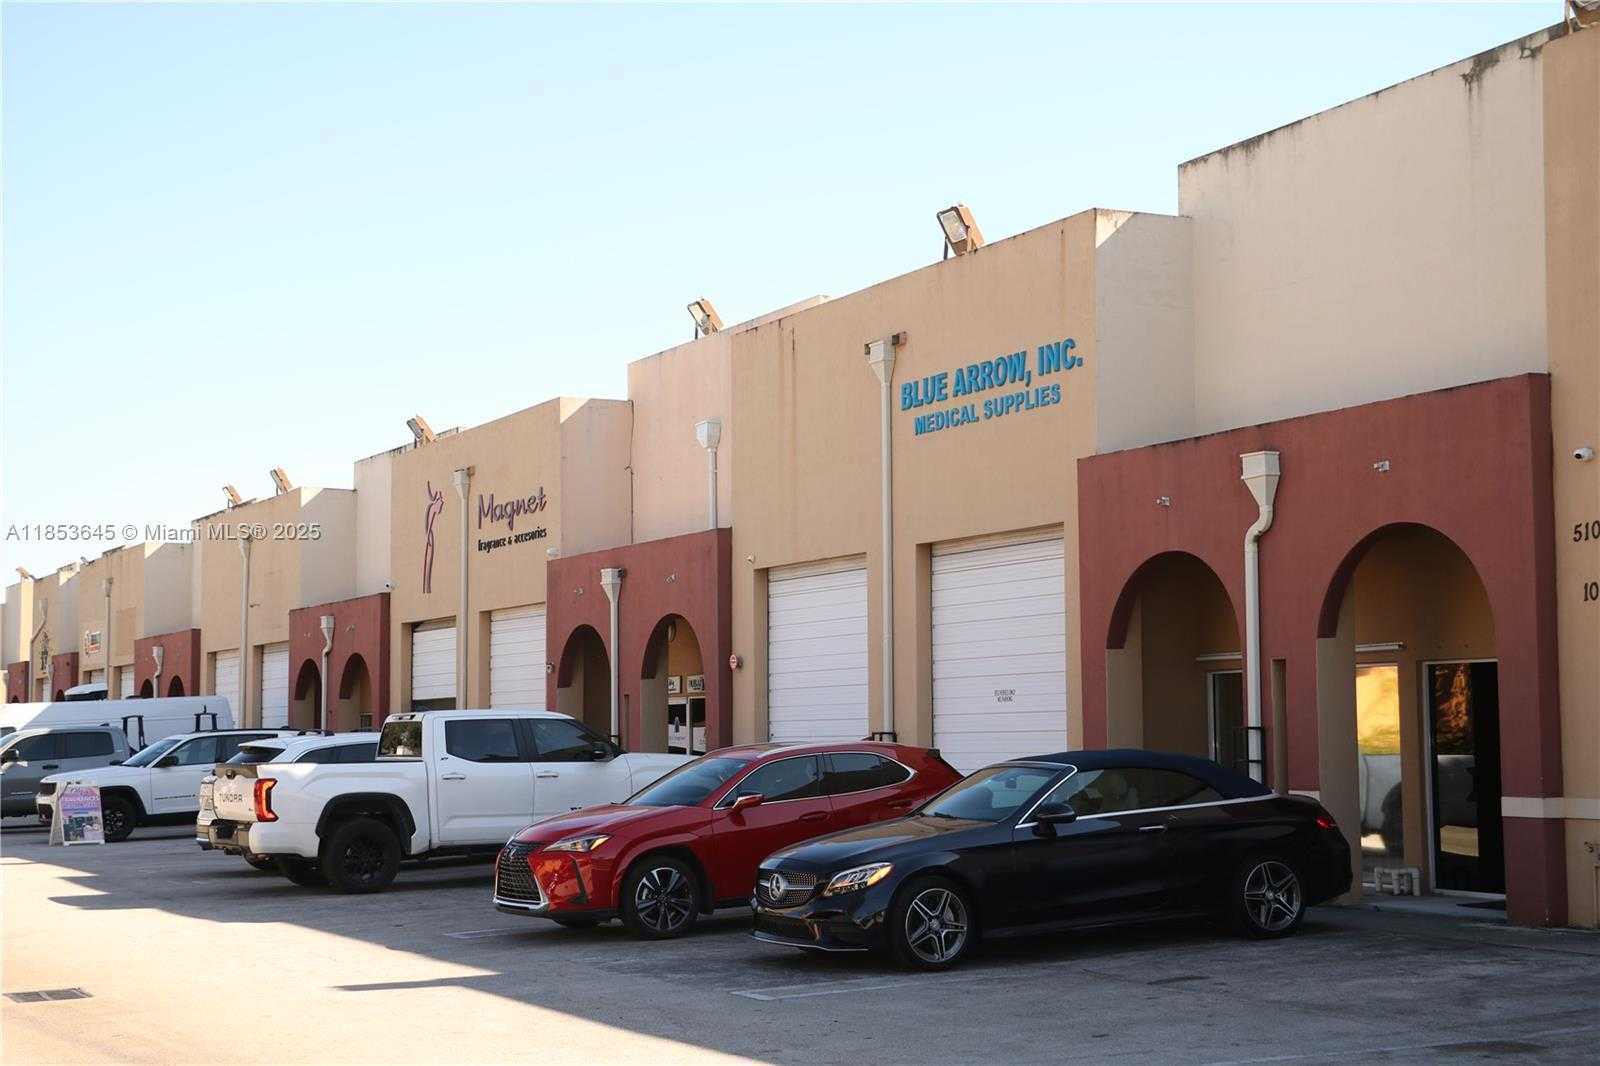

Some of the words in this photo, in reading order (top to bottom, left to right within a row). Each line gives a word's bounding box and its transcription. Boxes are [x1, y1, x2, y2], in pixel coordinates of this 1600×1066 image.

[900, 371, 948, 411] BLUE
[952, 351, 1031, 397] ARROW,
[1038, 338, 1083, 376] INC.
[914, 404, 979, 435] MEDICAL
[984, 384, 1061, 419] SUPPLIES
[478, 486, 547, 531] Magnet
[478, 538, 506, 553] fragrance
[507, 537, 512, 545] &
[1573, 520, 1600, 542] 510
[1584, 582, 1599, 601] 10
